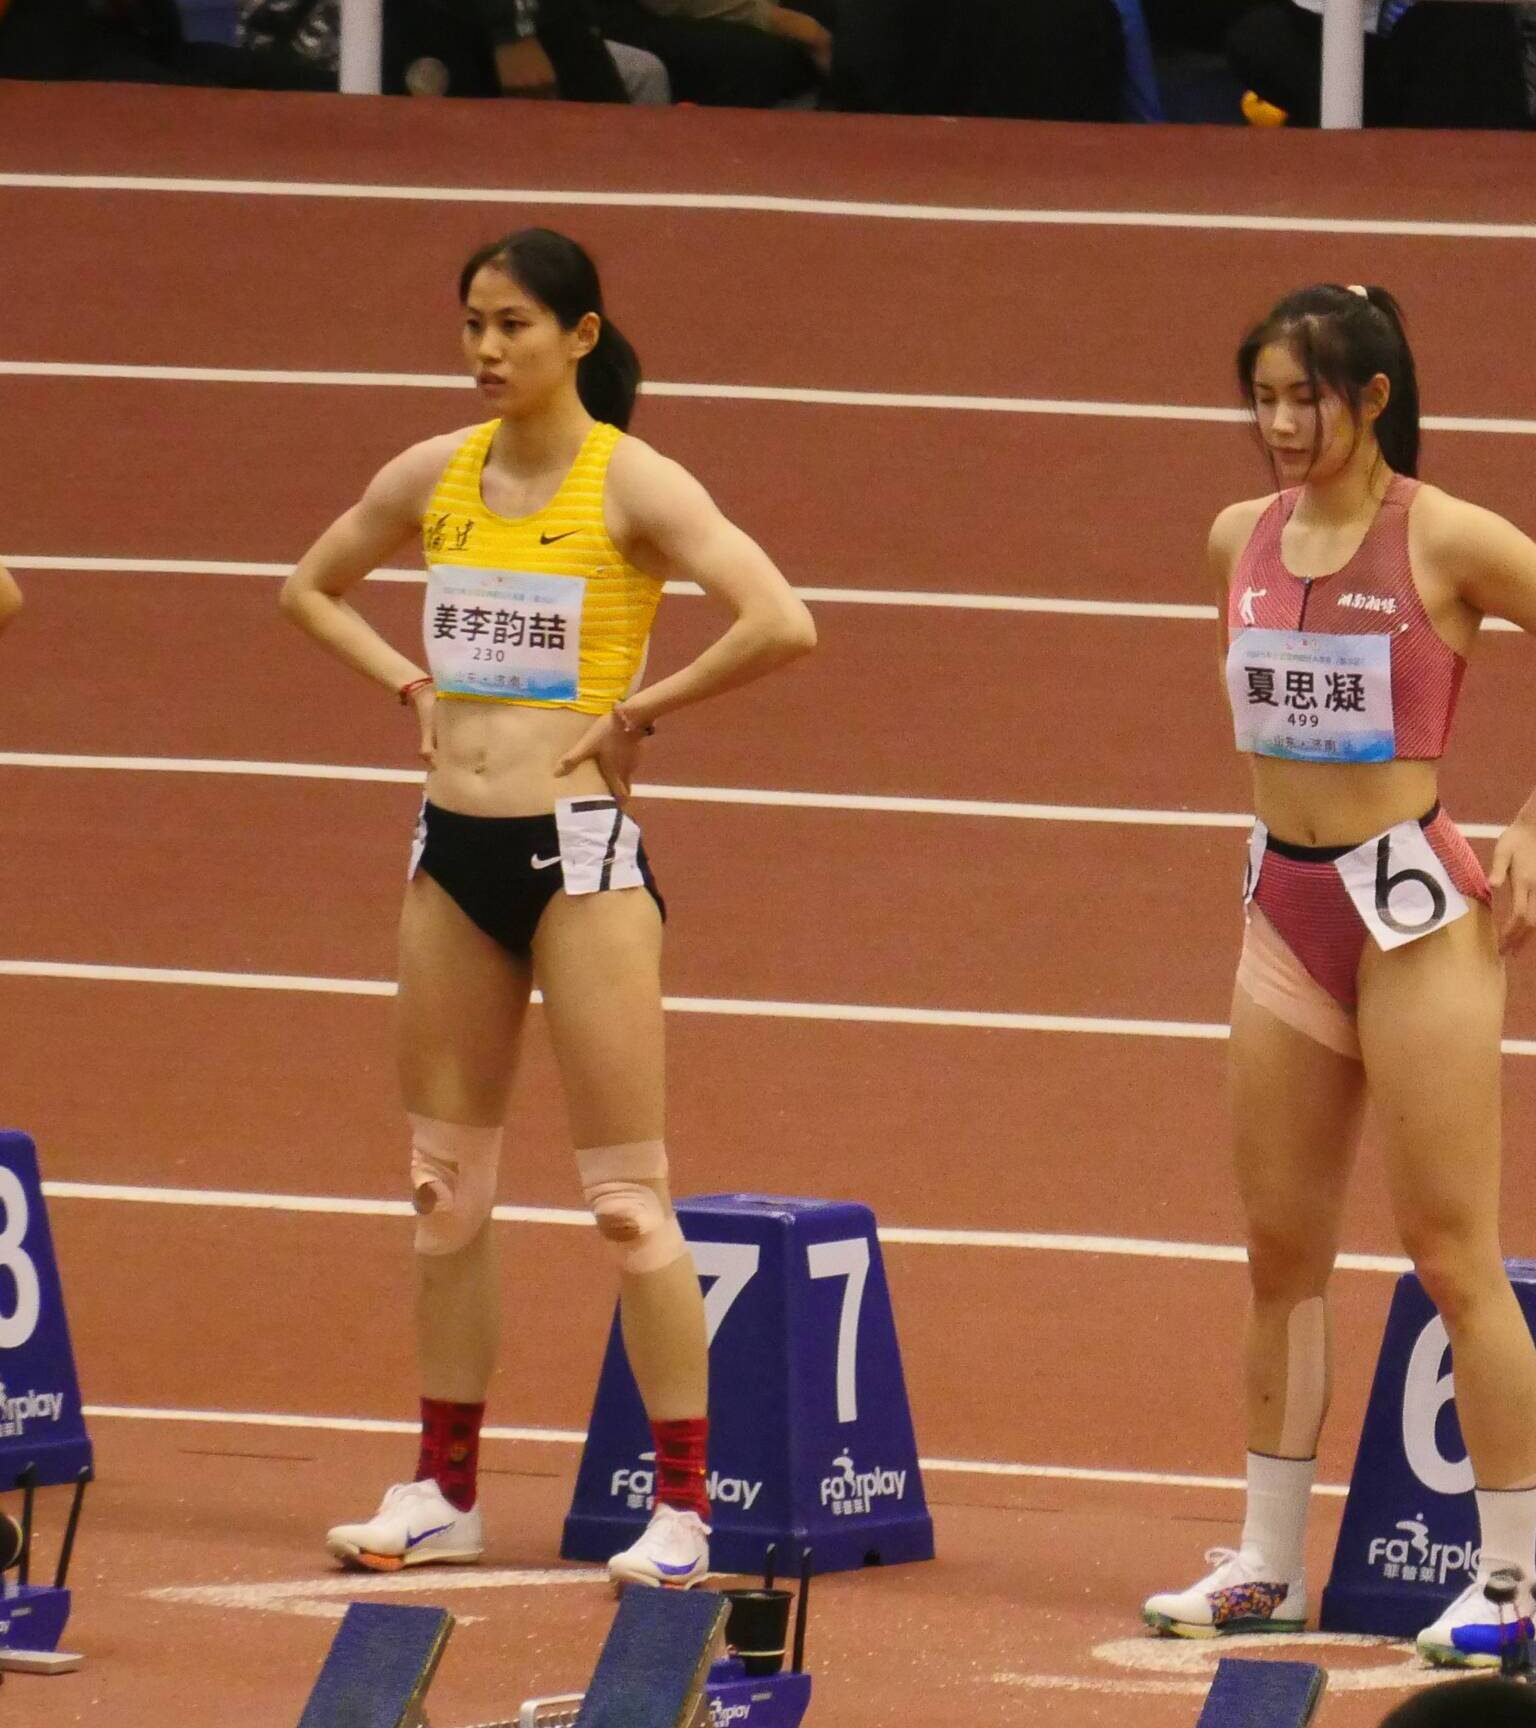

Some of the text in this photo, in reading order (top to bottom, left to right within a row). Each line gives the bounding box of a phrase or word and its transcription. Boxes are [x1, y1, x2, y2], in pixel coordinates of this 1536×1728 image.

[433, 603, 566, 650] 姜李韵喆
[472, 648, 505, 663] 230
[1244, 666, 1366, 712] 夏思凝
[1287, 713, 1320, 728] 499
[571, 800, 624, 891] 7
[1375, 833, 1447, 936] 6
[806, 1237, 870, 1423] 7
[1403, 1314, 1477, 1495] 6
[610, 1468, 762, 1510] Falay
[1368, 1512, 1482, 1585] Fairpl
